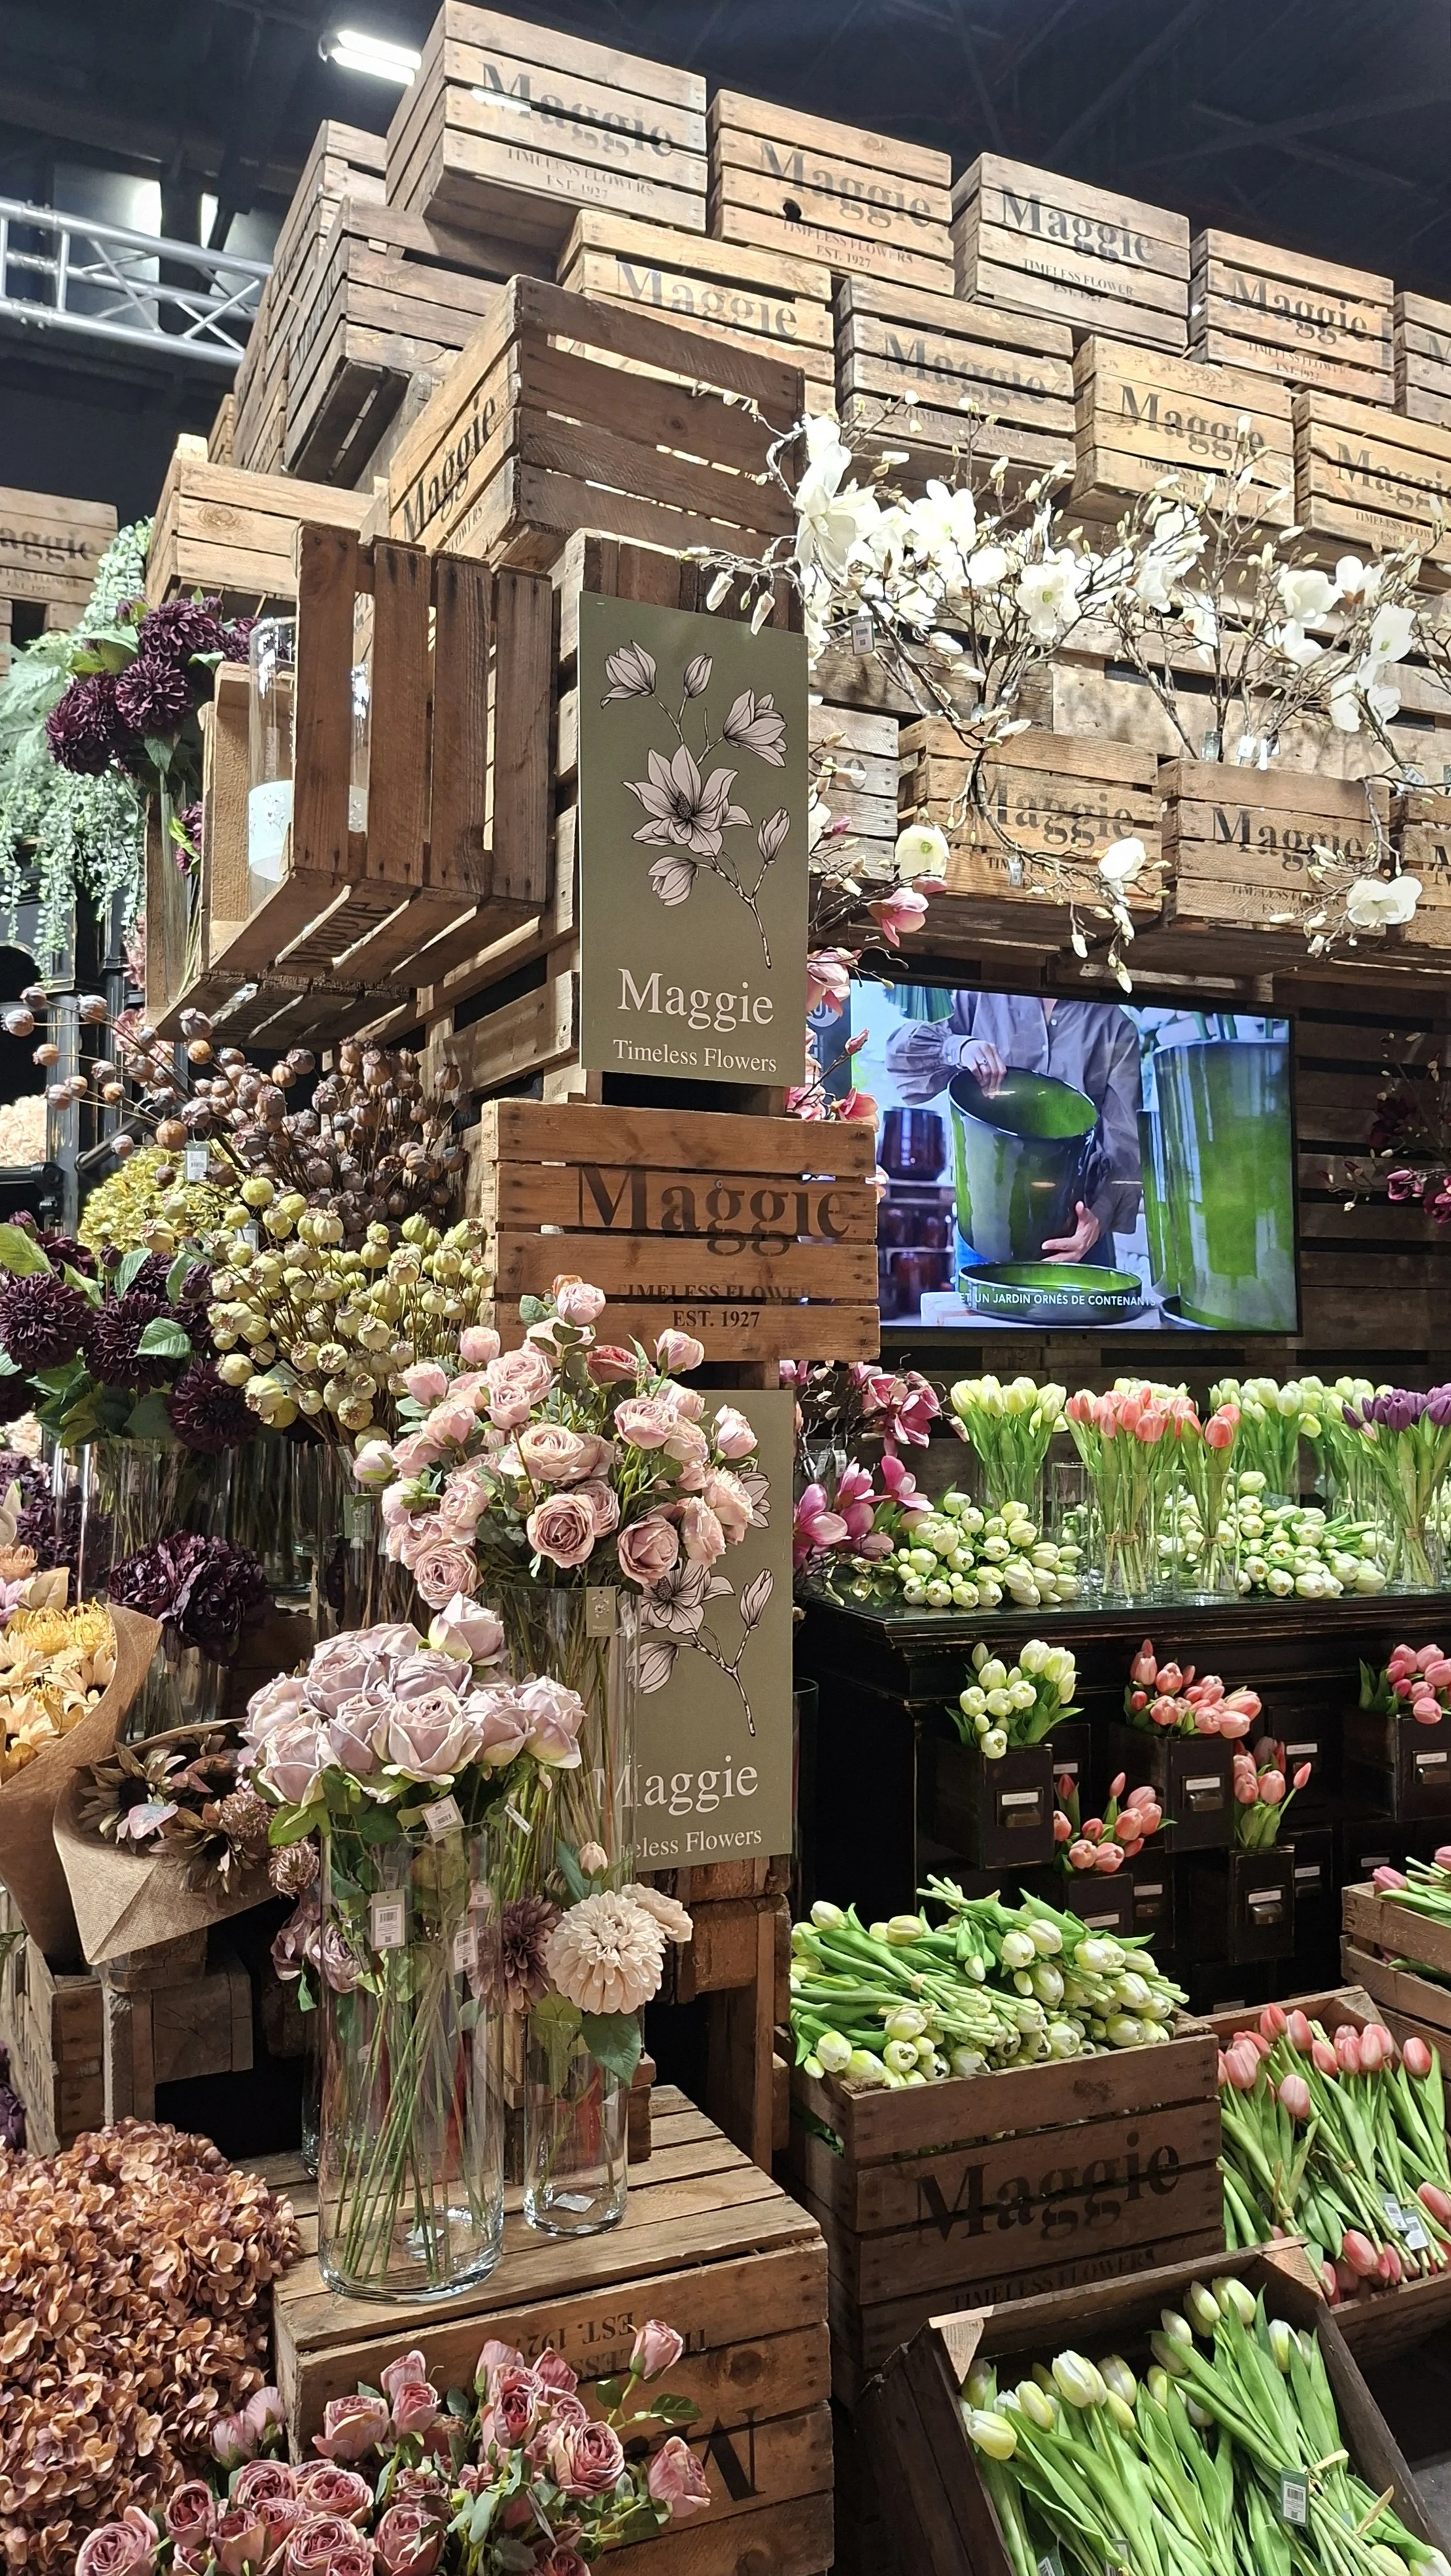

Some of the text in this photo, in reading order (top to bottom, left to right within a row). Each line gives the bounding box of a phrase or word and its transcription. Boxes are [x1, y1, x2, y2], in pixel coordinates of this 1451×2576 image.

[478, 61, 673, 158] Maggie
[760, 141, 932, 228] Maggie
[817, 245, 872, 268] EST. 1927
[996, 182, 1158, 264] Maggie
[616, 261, 798, 340] Maggie
[1023, 258, 1081, 282] TIMELESS
[1232, 272, 1368, 345] Maggie
[1119, 383, 1265, 461] Magge
[404, 396, 496, 542] Maggie
[1335, 441, 1451, 511] Maggi
[0, 527, 94, 564] aggie
[617, 968, 774, 1033] Maggie
[613, 1039, 777, 1073] Timeless Flowers
[577, 1164, 850, 1257] Maggie
[673, 1310, 760, 1328] EST. 1927
[959, 1293, 1156, 1307] ET UN JARDIN ORNÉS DE CONTENANTS
[592, 1755, 758, 1816] Maggie
[621, 1829, 762, 1859] eless Flowers
[917, 2131, 1179, 2242] Maggie
[515, 2312, 635, 2358] EST. 192
